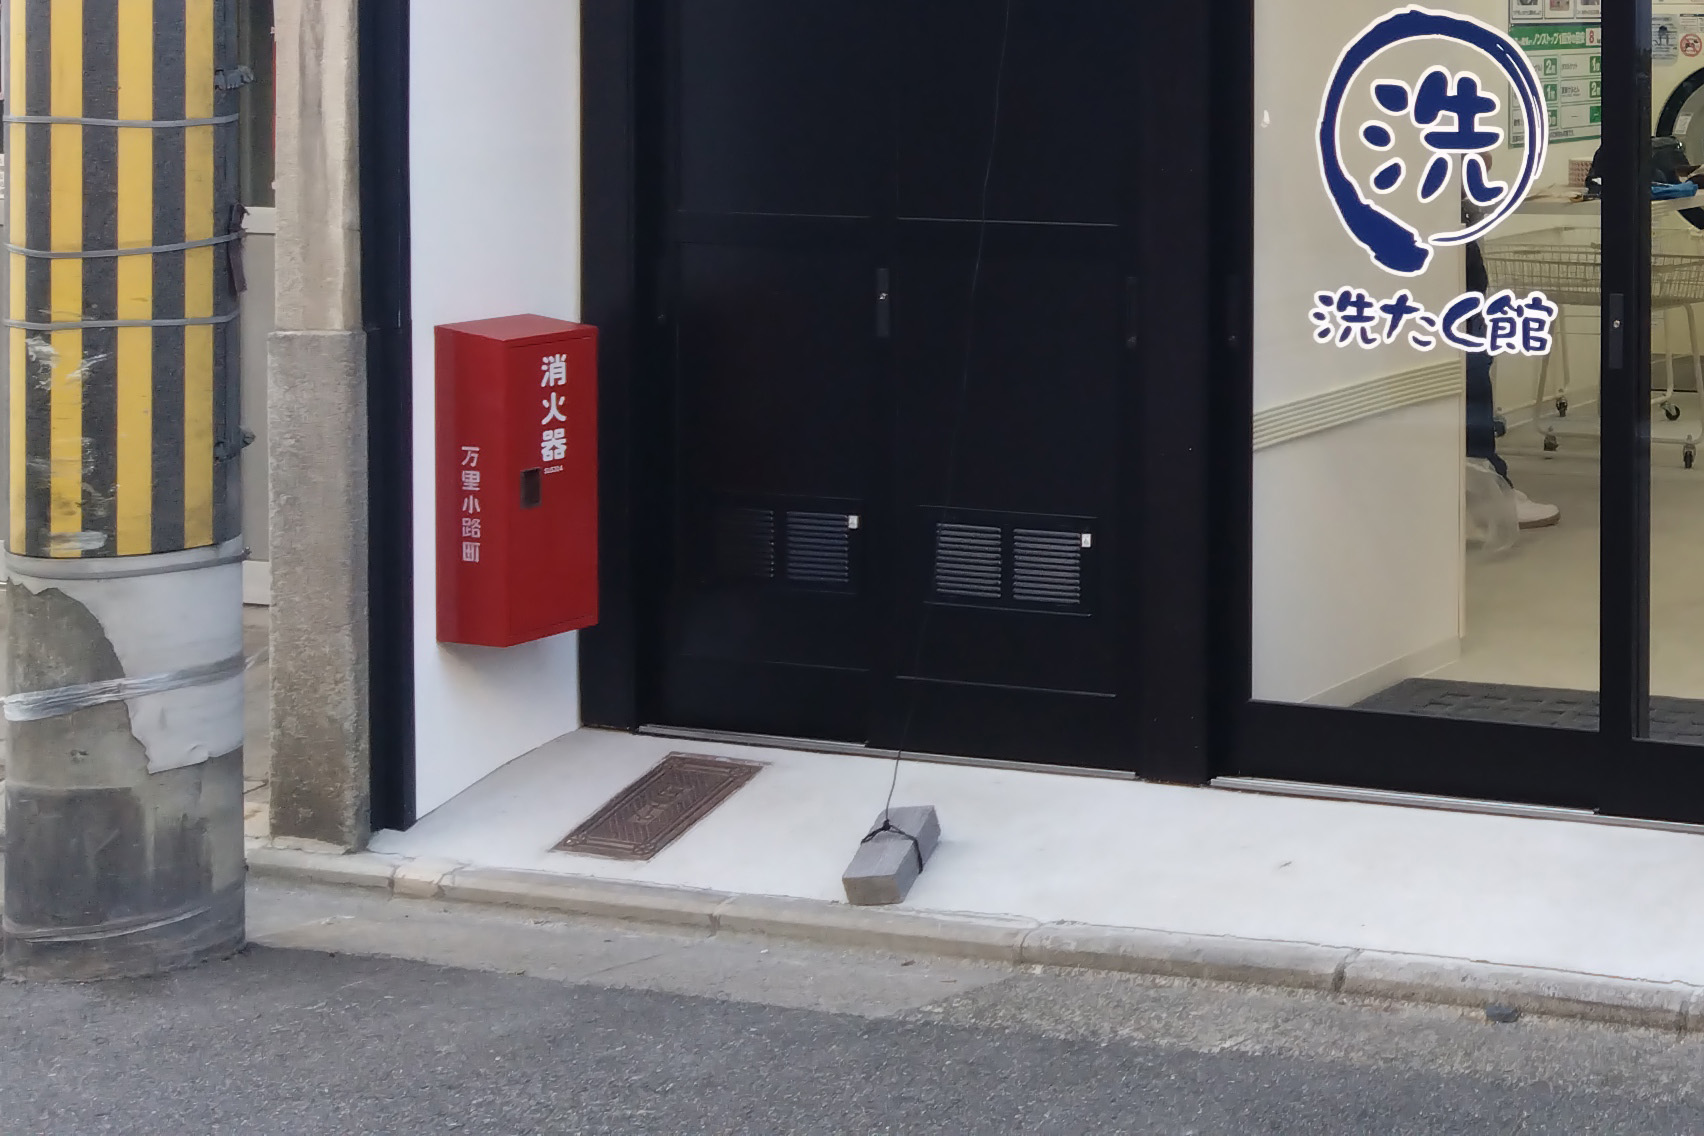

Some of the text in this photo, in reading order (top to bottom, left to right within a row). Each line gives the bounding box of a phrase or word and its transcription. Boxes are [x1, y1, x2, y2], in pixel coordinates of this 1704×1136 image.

[1361, 66, 1507, 202] 洗
[1312, 289, 1556, 356] 洗たく館
[540, 354, 568, 462] 消火器
[461, 445, 481, 563] 万里小路町
